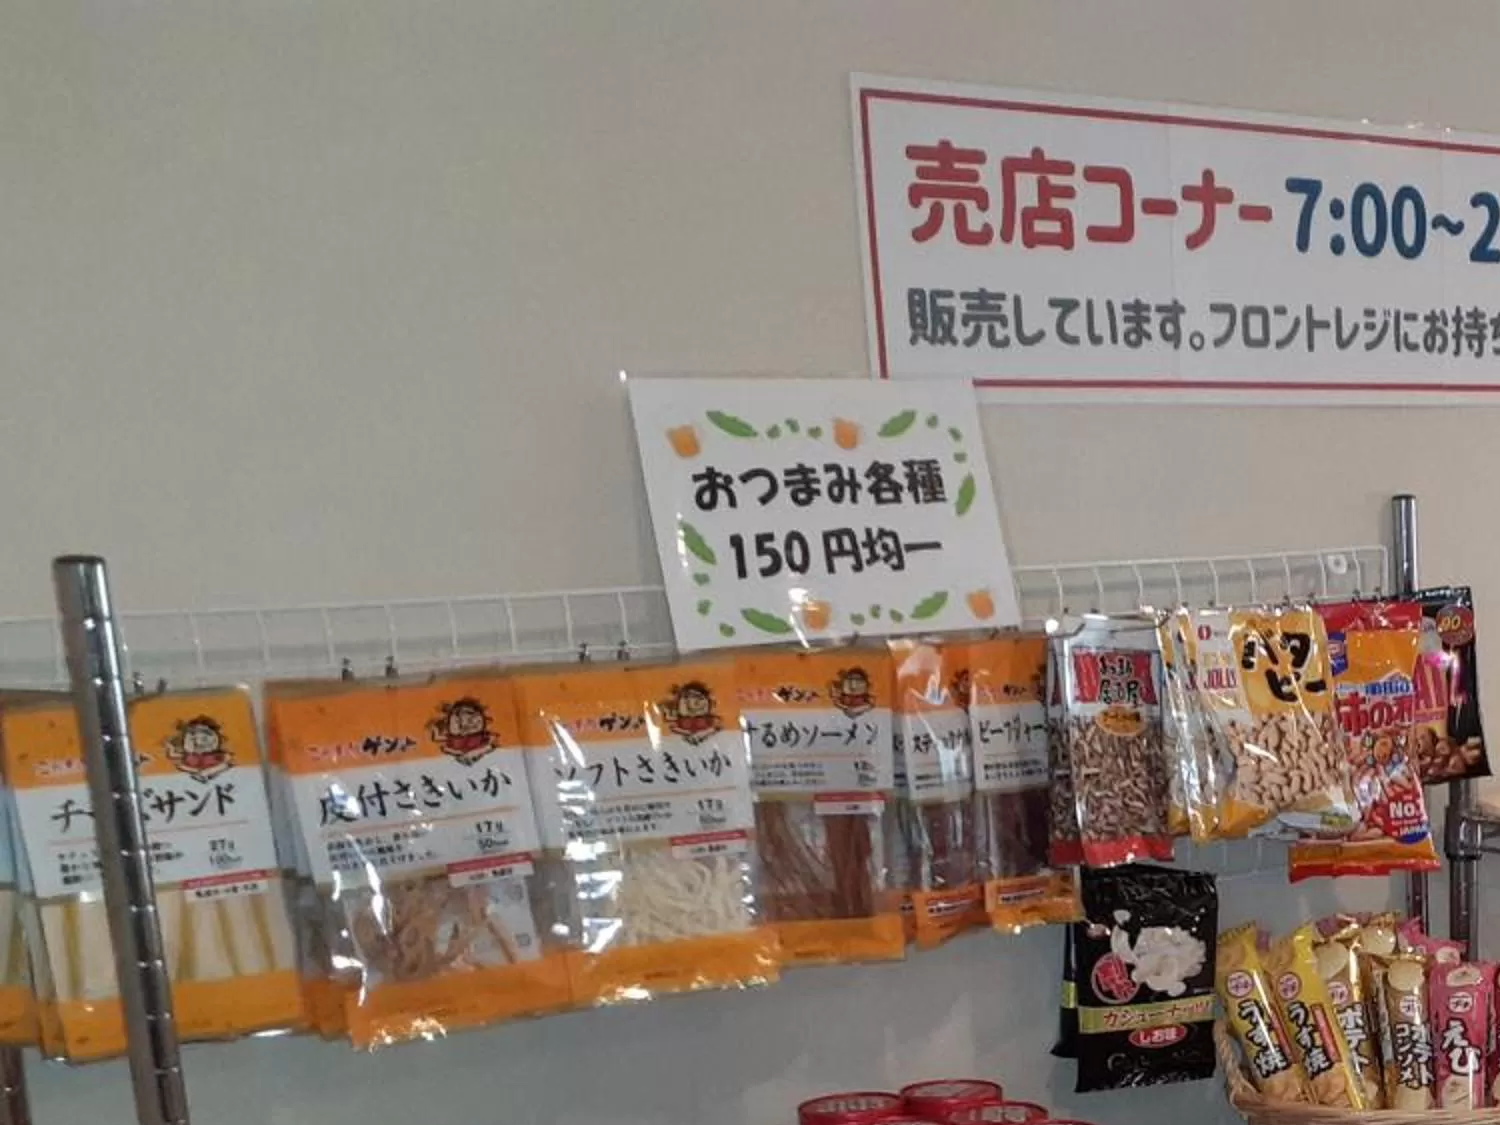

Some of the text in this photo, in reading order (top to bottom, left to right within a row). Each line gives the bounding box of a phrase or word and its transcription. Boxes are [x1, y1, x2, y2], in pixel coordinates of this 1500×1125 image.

[905, 138, 1273, 252] 売店コーナー
[691, 457, 948, 512] おつまみ各種
[50, 783, 236, 834] チーサンド
